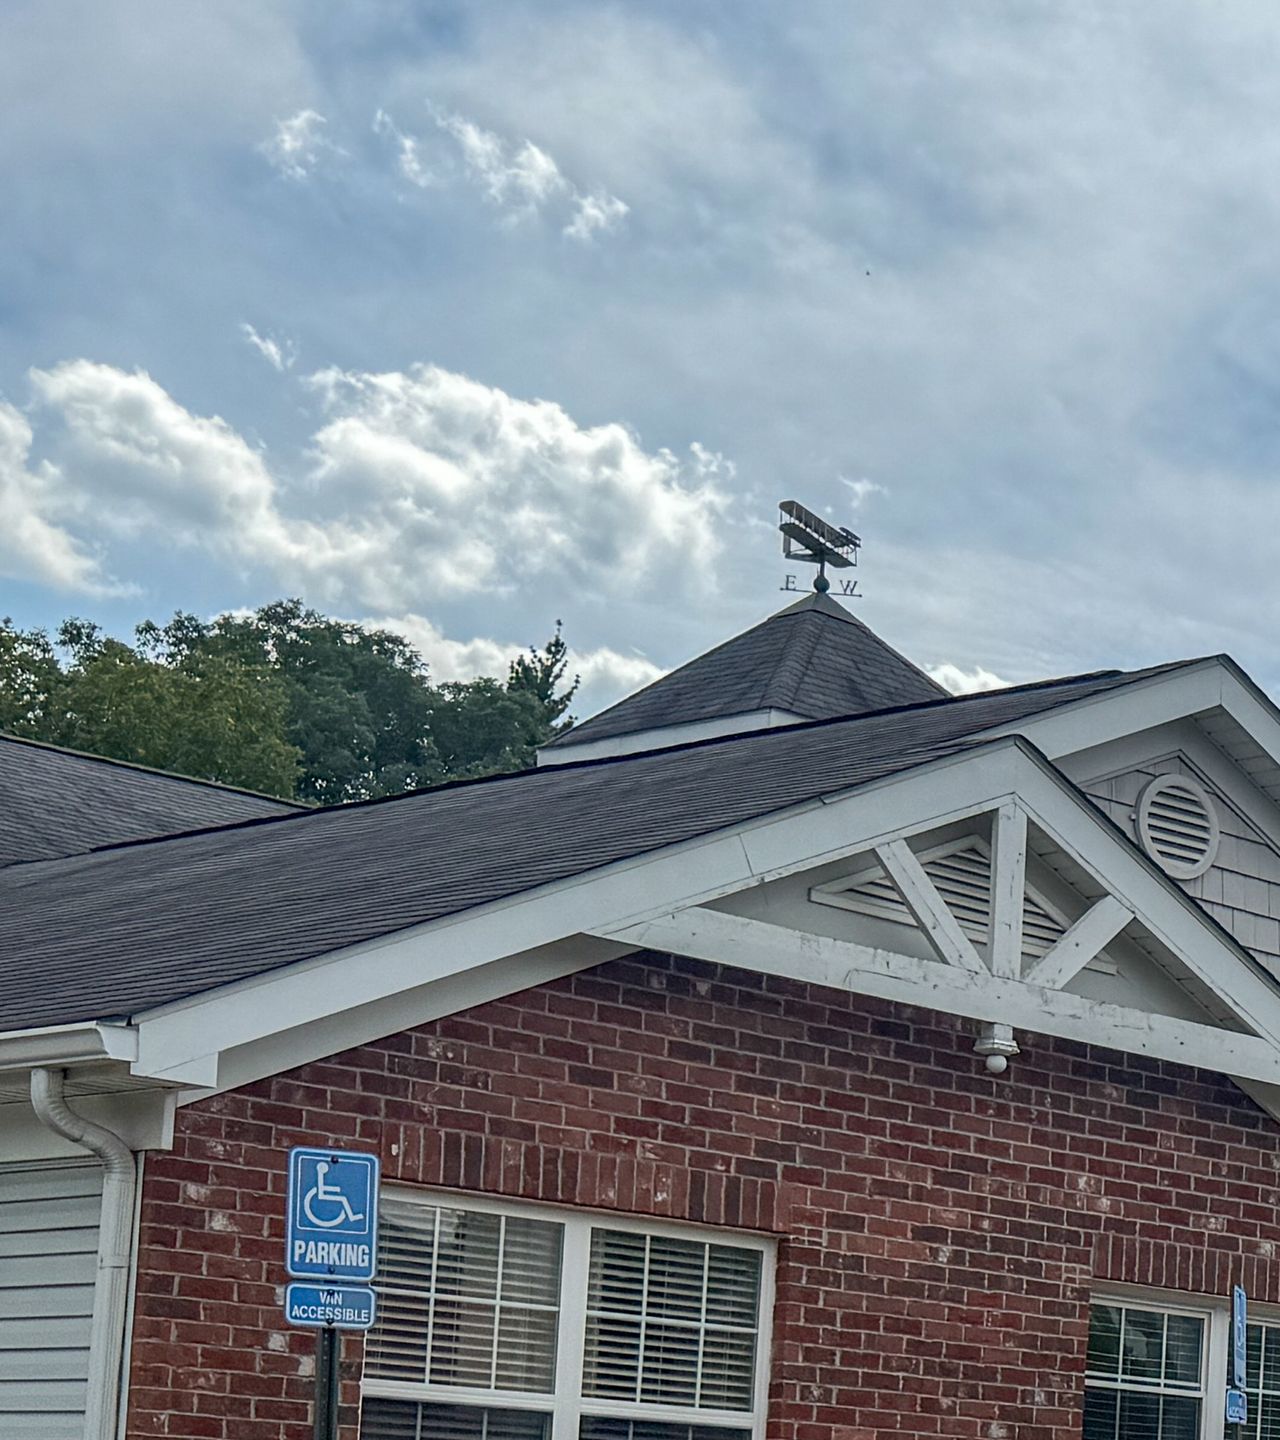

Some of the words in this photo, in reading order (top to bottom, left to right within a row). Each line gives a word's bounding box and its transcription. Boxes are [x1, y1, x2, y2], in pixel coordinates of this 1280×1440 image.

[785, 575, 797, 590] E
[839, 580, 858, 594] W
[294, 1239, 370, 1268] PARKING
[320, 1291, 343, 1305] VAN
[291, 1305, 370, 1322] ACCESSIBLE
